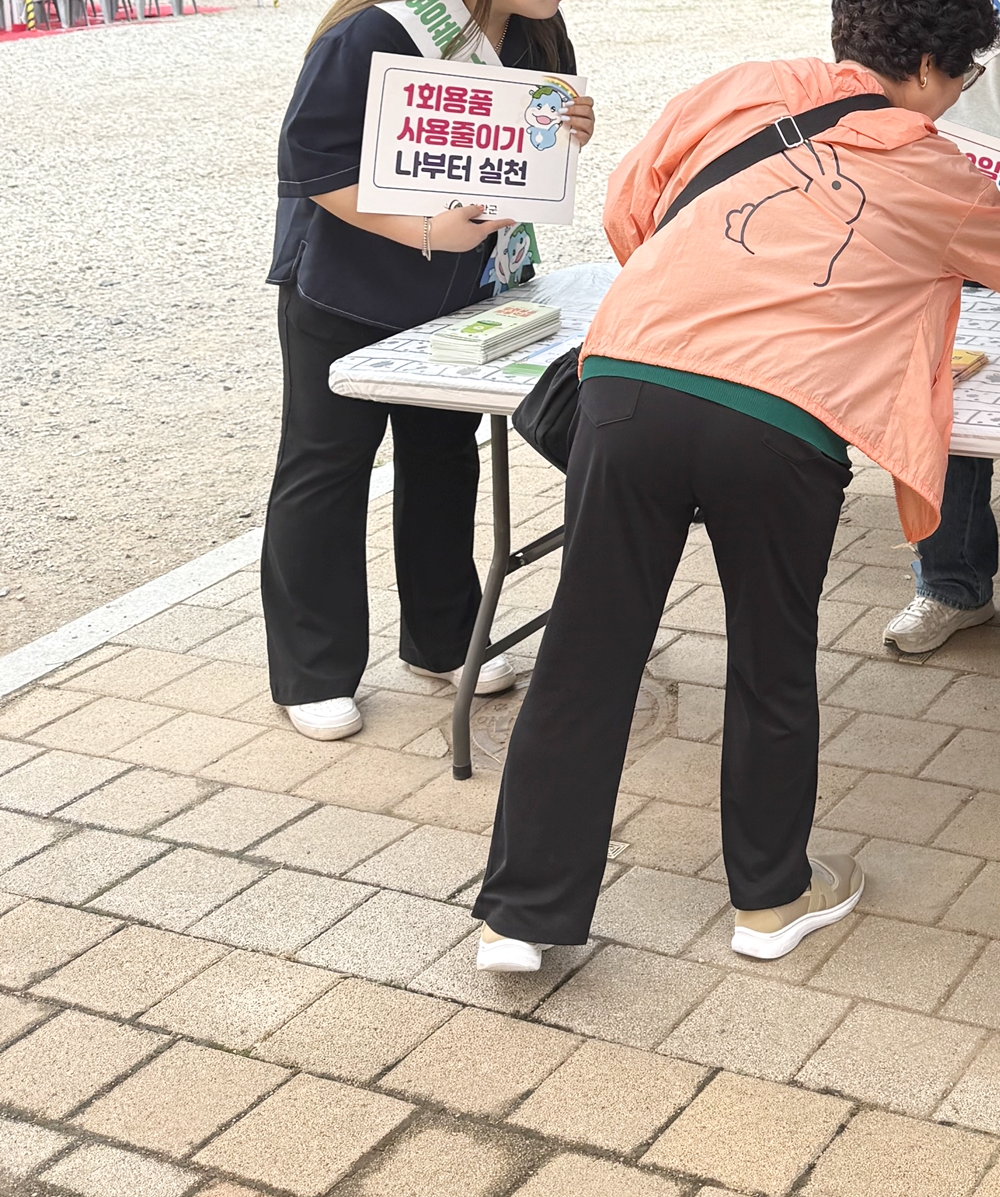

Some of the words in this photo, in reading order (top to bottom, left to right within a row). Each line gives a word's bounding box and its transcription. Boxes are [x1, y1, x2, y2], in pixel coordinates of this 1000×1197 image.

[403, 83, 493, 116] 1회용품
[397, 116, 525, 153] 사용줄이기
[395, 150, 472, 182] 나부터
[479, 157, 528, 187] 실천
